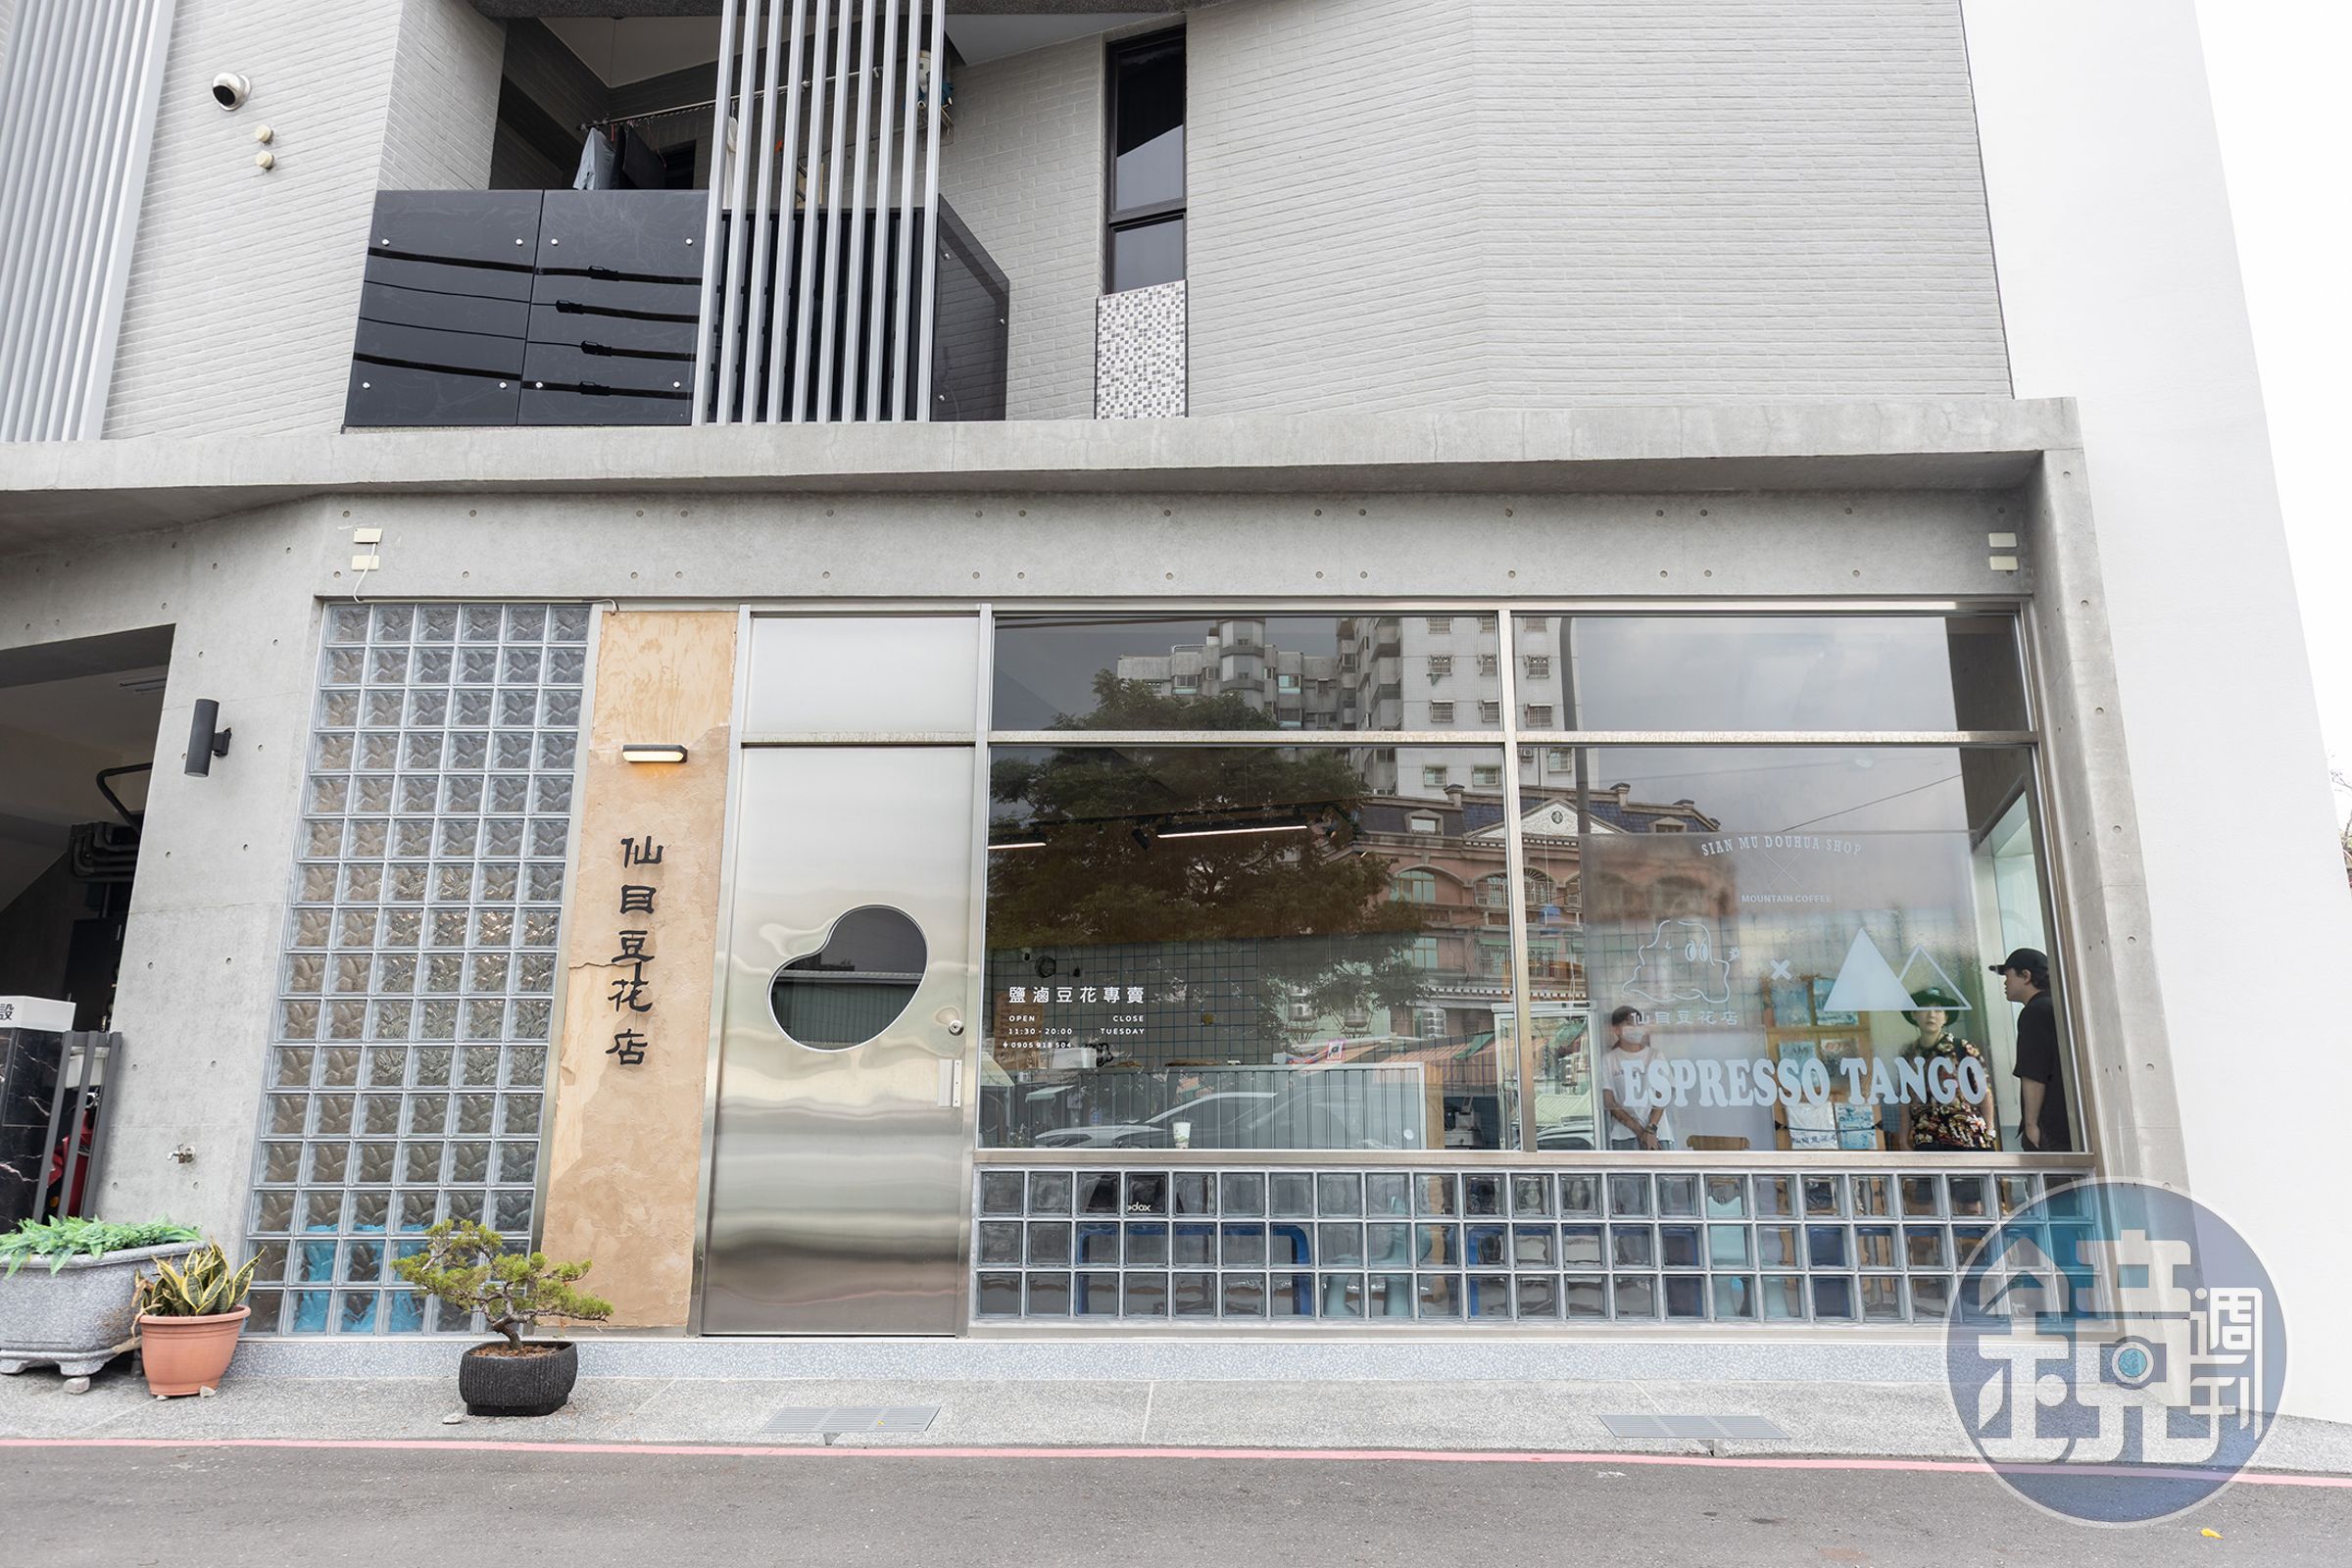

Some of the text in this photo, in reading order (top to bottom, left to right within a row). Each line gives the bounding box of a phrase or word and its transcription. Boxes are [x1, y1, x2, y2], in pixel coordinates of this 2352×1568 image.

[1701, 835, 1862, 857] SIAN MU DOUHUA SHOP
[1740, 894, 1833, 903] MOUNTAIN COFFEE
[605, 835, 664, 1066] 仙目豆花店
[1008, 986, 1145, 1004] 鹽滷豆花專賣
[1008, 1014, 1036, 1023] OPEN
[1112, 1014, 1145, 1023] CLOSE
[1631, 1009, 1739, 1026] 仙目豆花店
[1620, 1055, 1987, 1107] ESPRESSO TANGO
